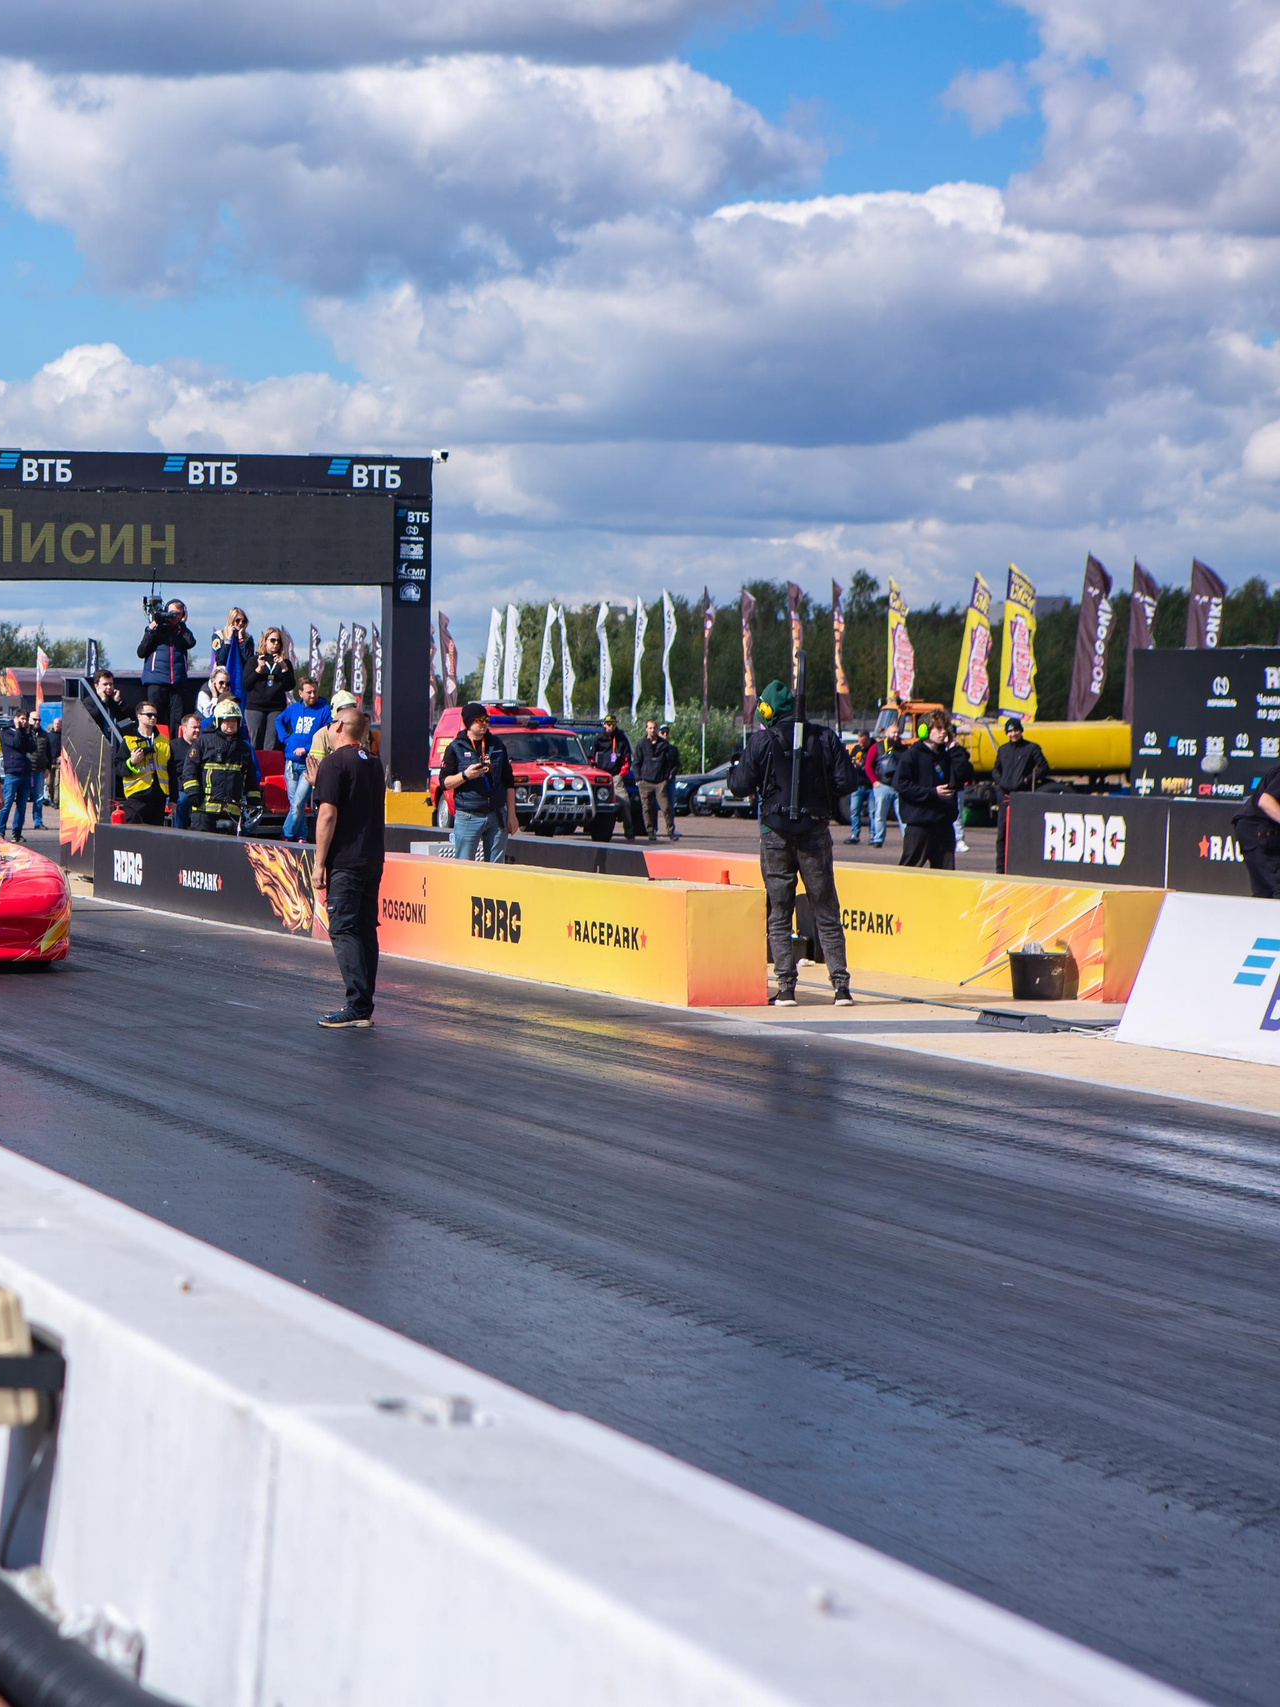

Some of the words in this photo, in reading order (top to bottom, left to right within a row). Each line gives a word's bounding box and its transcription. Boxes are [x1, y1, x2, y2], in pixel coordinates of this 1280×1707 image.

[22, 457, 72, 483] ВТБ
[188, 461, 238, 486] ВТБ
[352, 464, 402, 489] ВТБ
[407, 511, 430, 524] ВТБ
[1206, 597, 1223, 648] ONKI
[1177, 739, 1197, 756] ВТБ
[1043, 811, 1127, 866] RDRC
[113, 850, 143, 886] RDRC
[182, 869, 218, 892] RACEPARK
[382, 898, 427, 925] ROSGONKI
[471, 895, 522, 944] RDRC
[842, 908, 895, 936] CEPARK
[574, 919, 640, 951] RACEPARK
